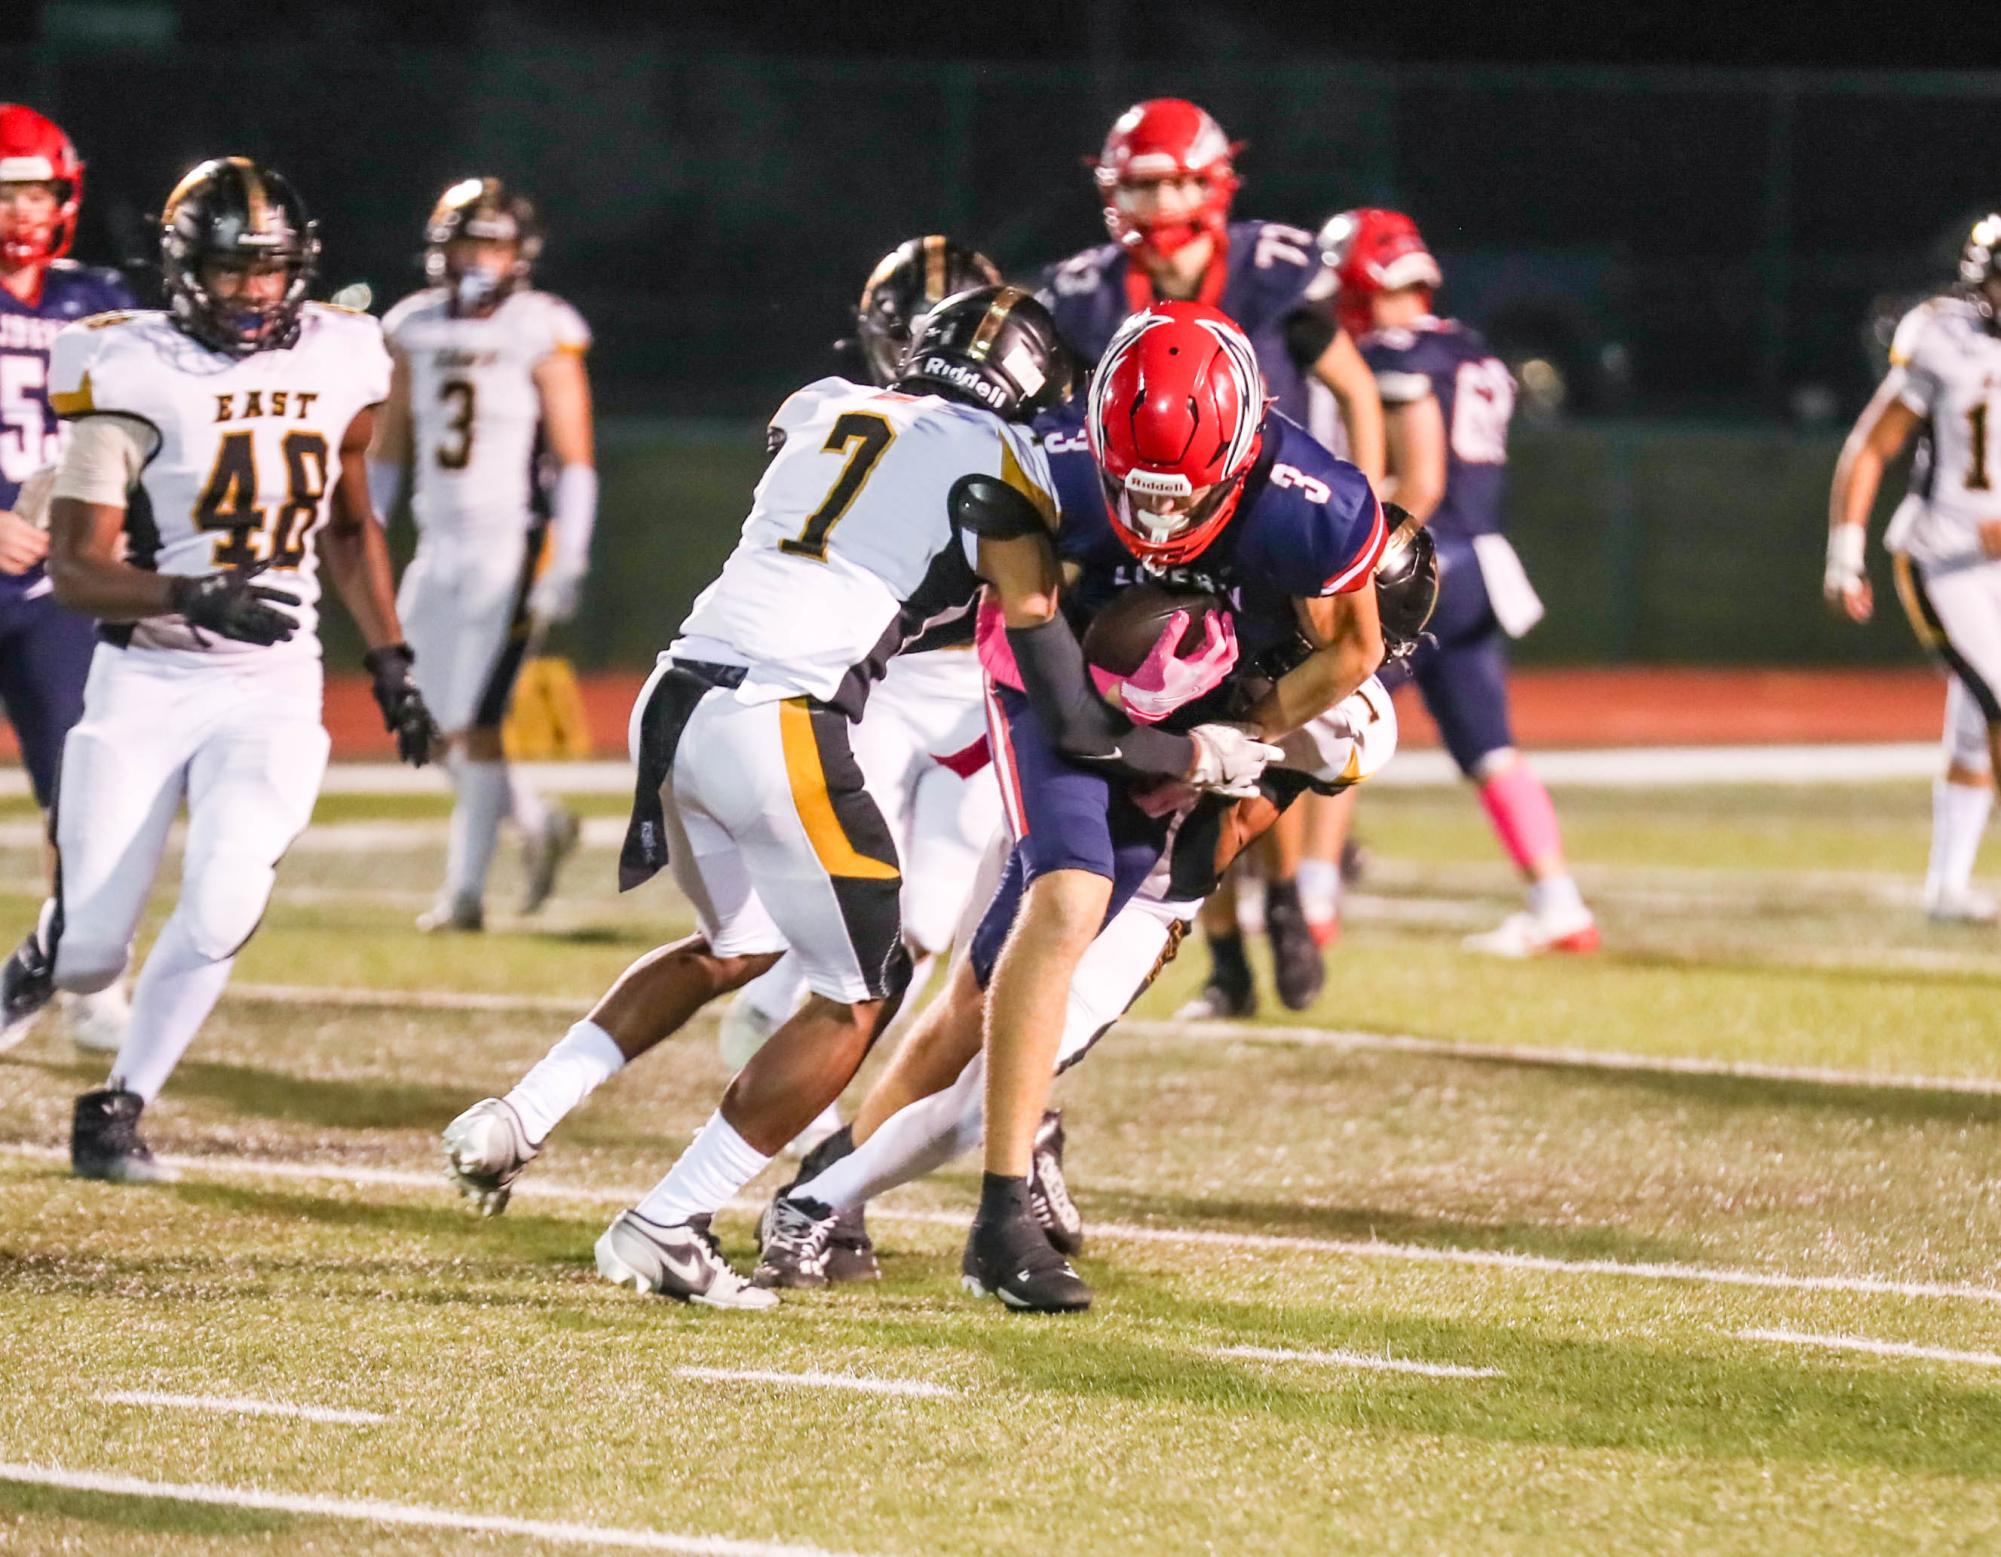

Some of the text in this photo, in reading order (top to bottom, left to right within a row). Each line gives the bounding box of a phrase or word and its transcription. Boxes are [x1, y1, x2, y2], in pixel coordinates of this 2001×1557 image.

[924, 357, 1007, 408] Riddell
[212, 391, 318, 423] EAST
[436, 379, 477, 469] 3
[1044, 429, 1088, 454] 3
[189, 430, 328, 571] 48
[777, 411, 897, 563] 7
[1131, 476, 1184, 491] Riddell
[1269, 462, 1331, 504] 3
